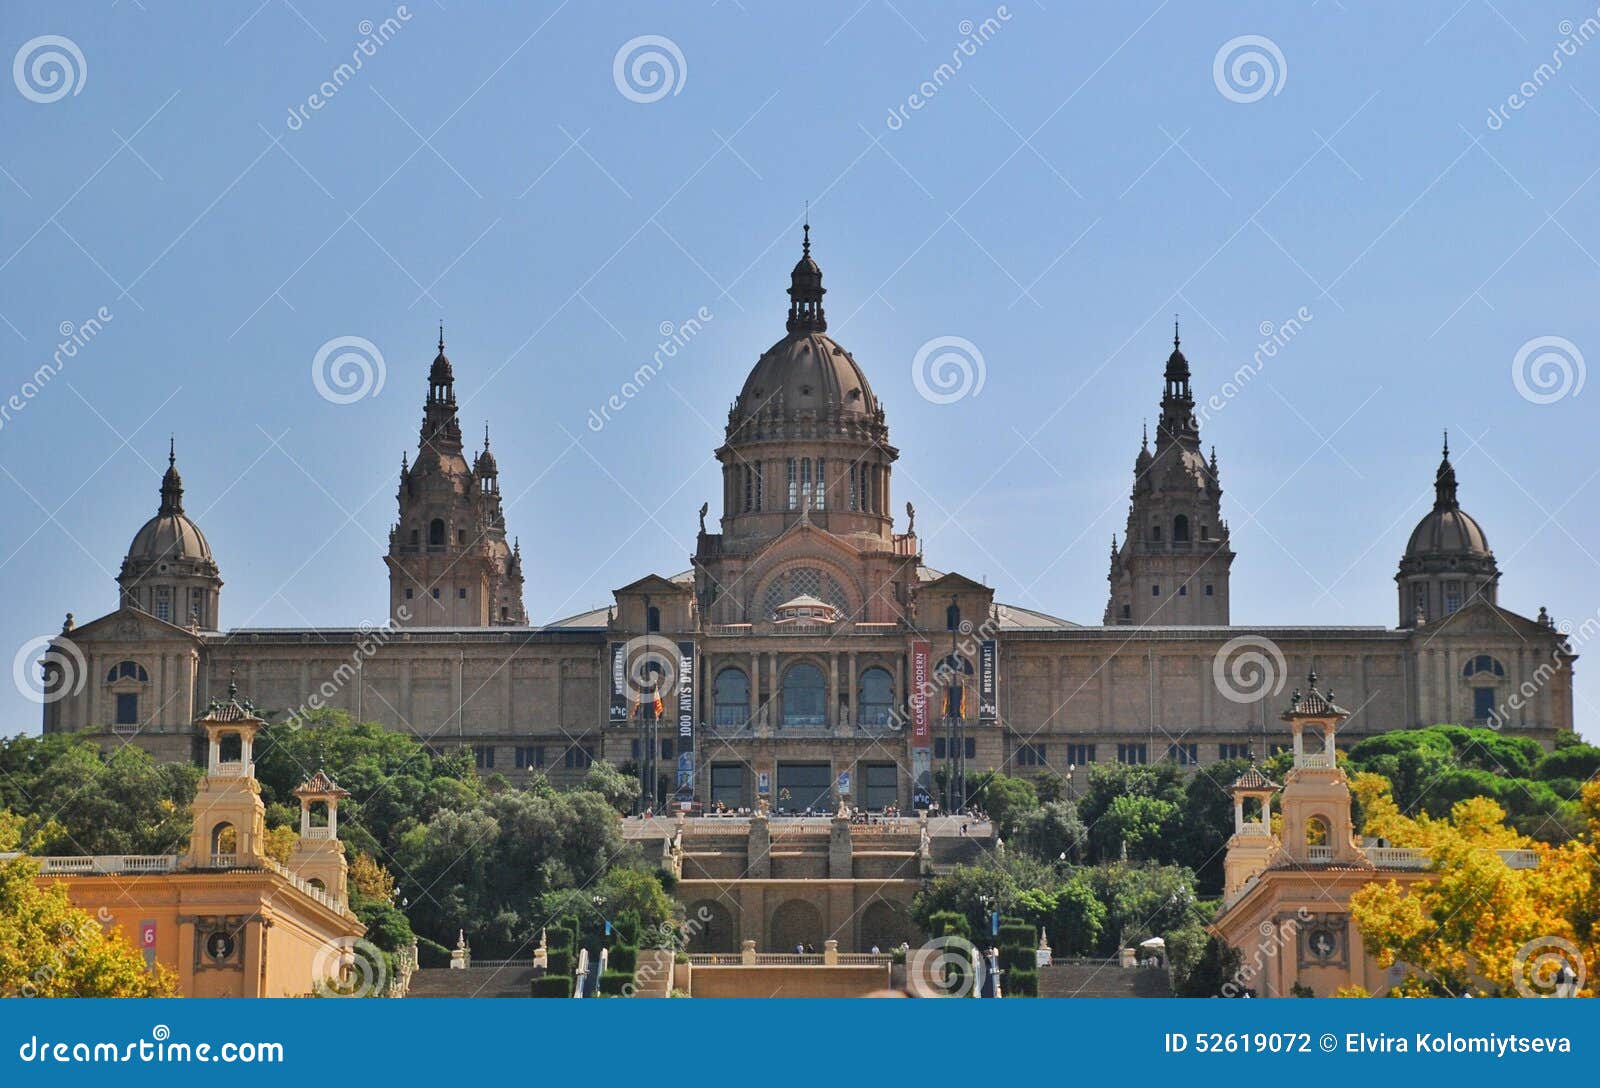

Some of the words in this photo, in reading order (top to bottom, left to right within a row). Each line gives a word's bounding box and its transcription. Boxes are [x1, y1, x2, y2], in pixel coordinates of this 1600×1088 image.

[680, 655, 692, 683] D'ART
[916, 653, 924, 689] MODERN
[680, 687, 692, 711] ANYS
[680, 715, 692, 737] 1000
[916, 727, 924, 736] EL
[145, 929, 153, 943] 6
